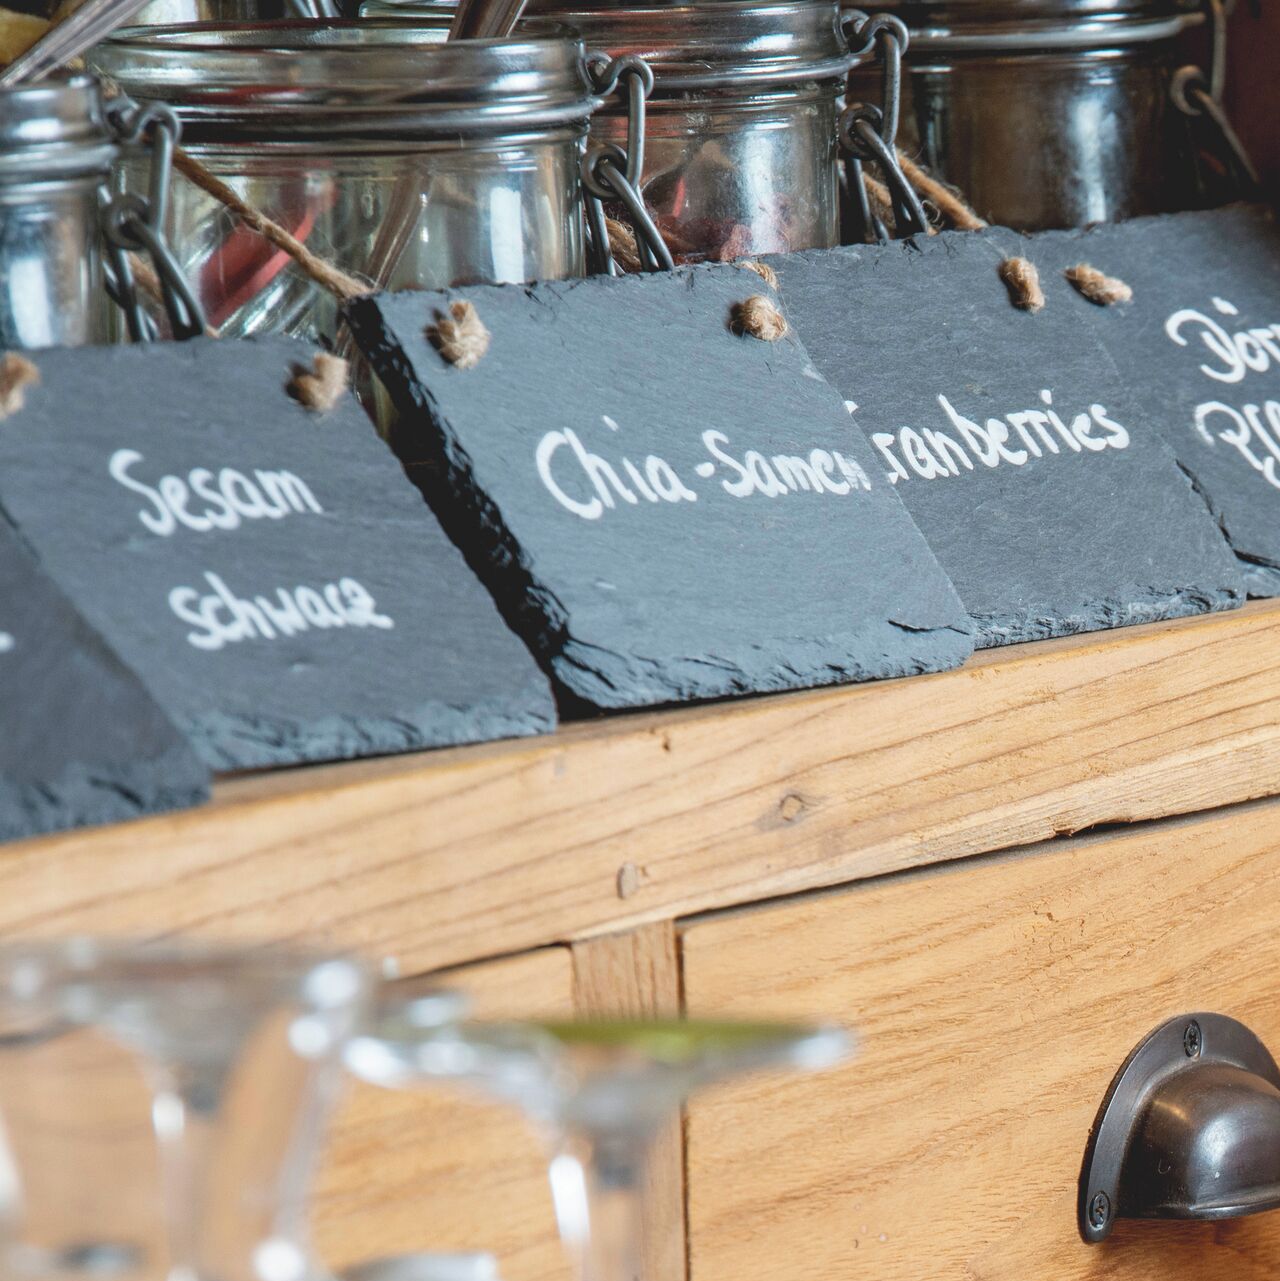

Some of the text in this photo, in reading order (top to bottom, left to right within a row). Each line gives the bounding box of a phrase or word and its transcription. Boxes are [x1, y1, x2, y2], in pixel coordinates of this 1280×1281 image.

[535, 414, 872, 520] Chia-Samen
[844, 388, 1131, 484] ranberries
[109, 448, 323, 536] Sesam
